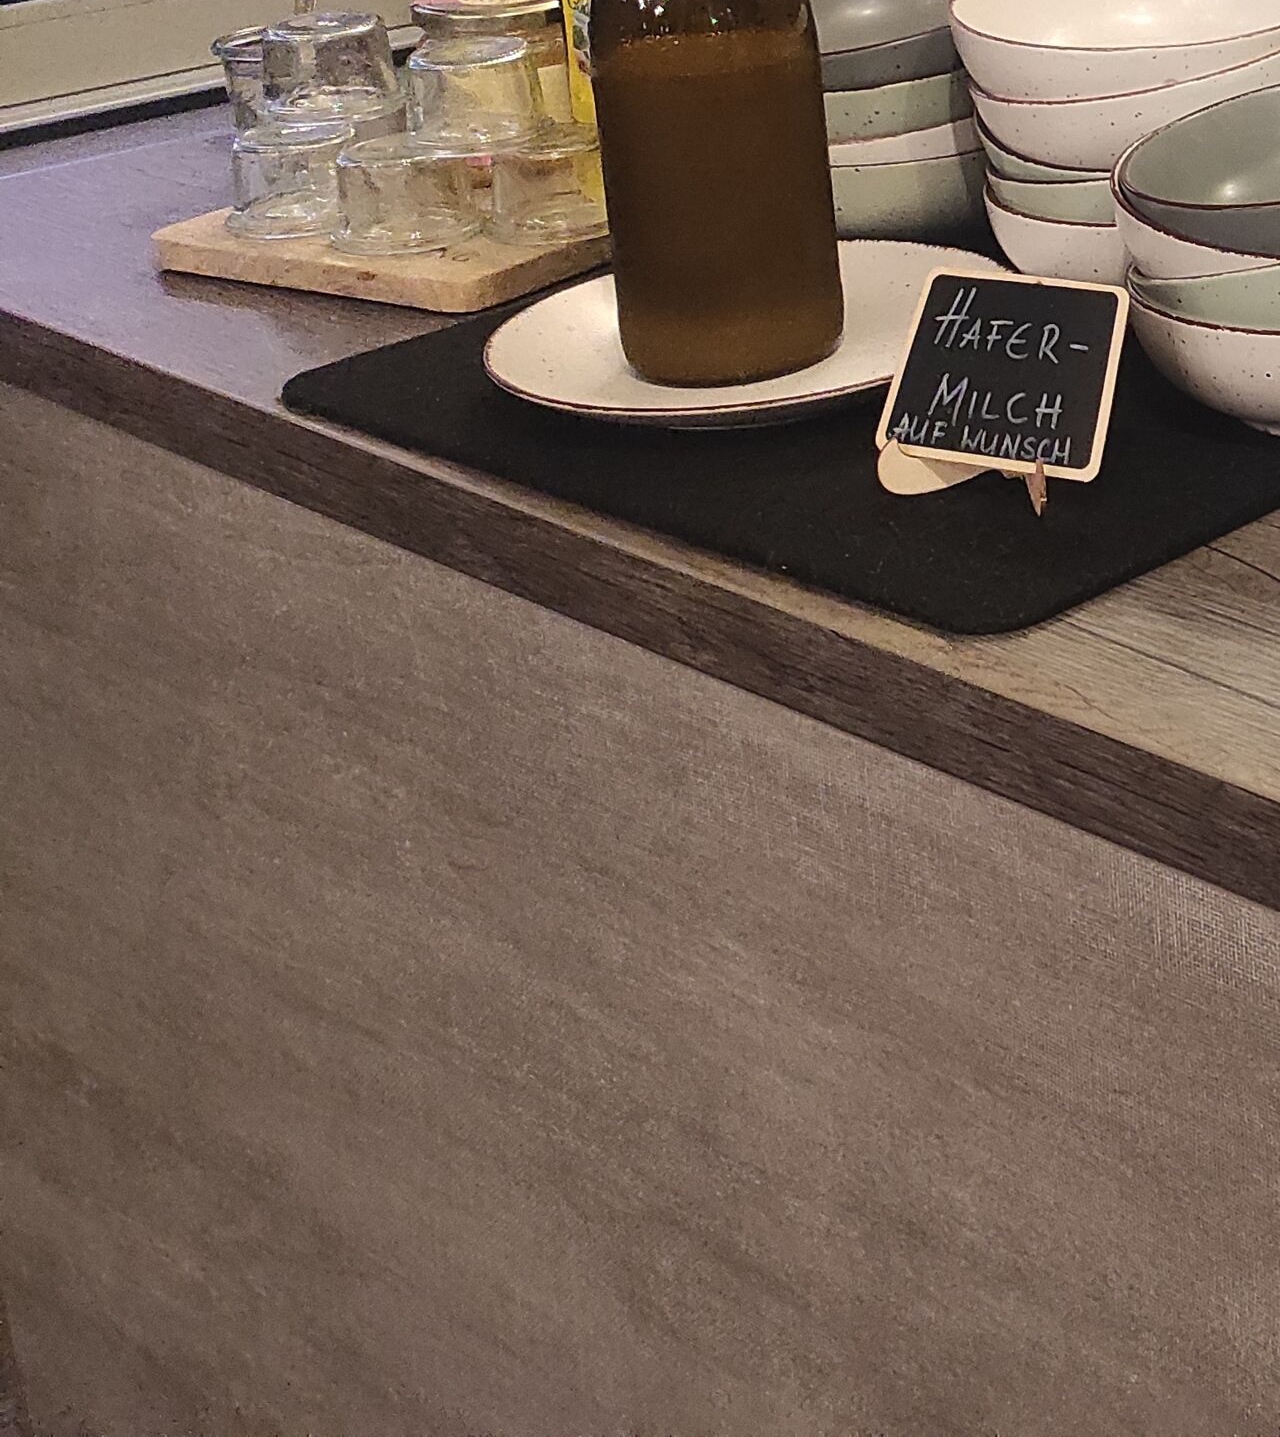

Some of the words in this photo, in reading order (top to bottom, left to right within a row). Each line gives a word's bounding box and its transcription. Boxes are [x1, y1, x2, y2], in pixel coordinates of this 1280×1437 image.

[934, 286, 1089, 364] HAFER-
[927, 372, 1062, 431] MILCH
[891, 412, 948, 444] AUF
[961, 424, 1071, 465] WUNSCH
